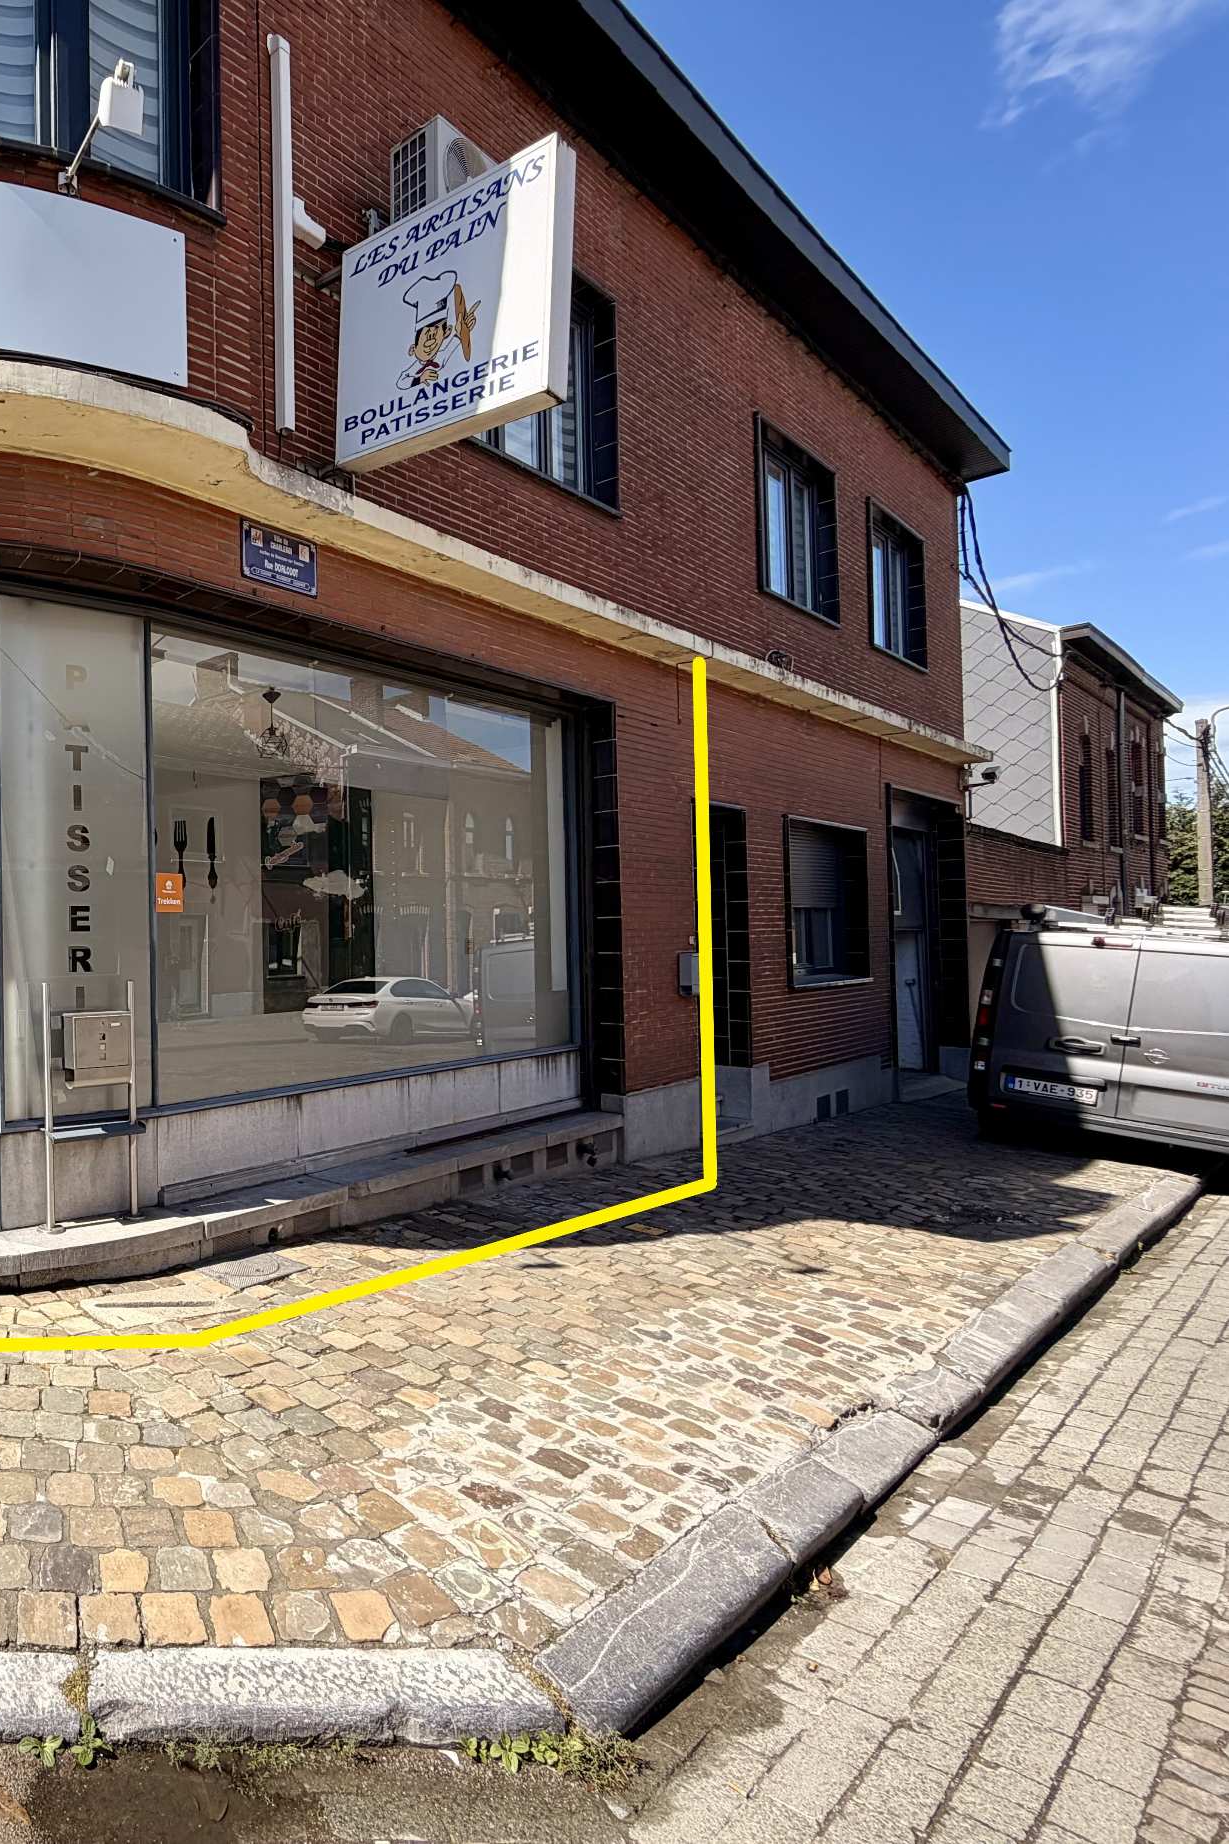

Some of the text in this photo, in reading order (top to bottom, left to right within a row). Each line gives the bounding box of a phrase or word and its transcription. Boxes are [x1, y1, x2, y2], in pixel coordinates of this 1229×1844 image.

[350, 154, 546, 278] LES ARTISANS
[378, 201, 508, 288] DU PAIN
[344, 340, 540, 433] BOULANGERIE
[360, 372, 516, 445] PATISSERIE
[64, 664, 92, 1009] PTISSERI
